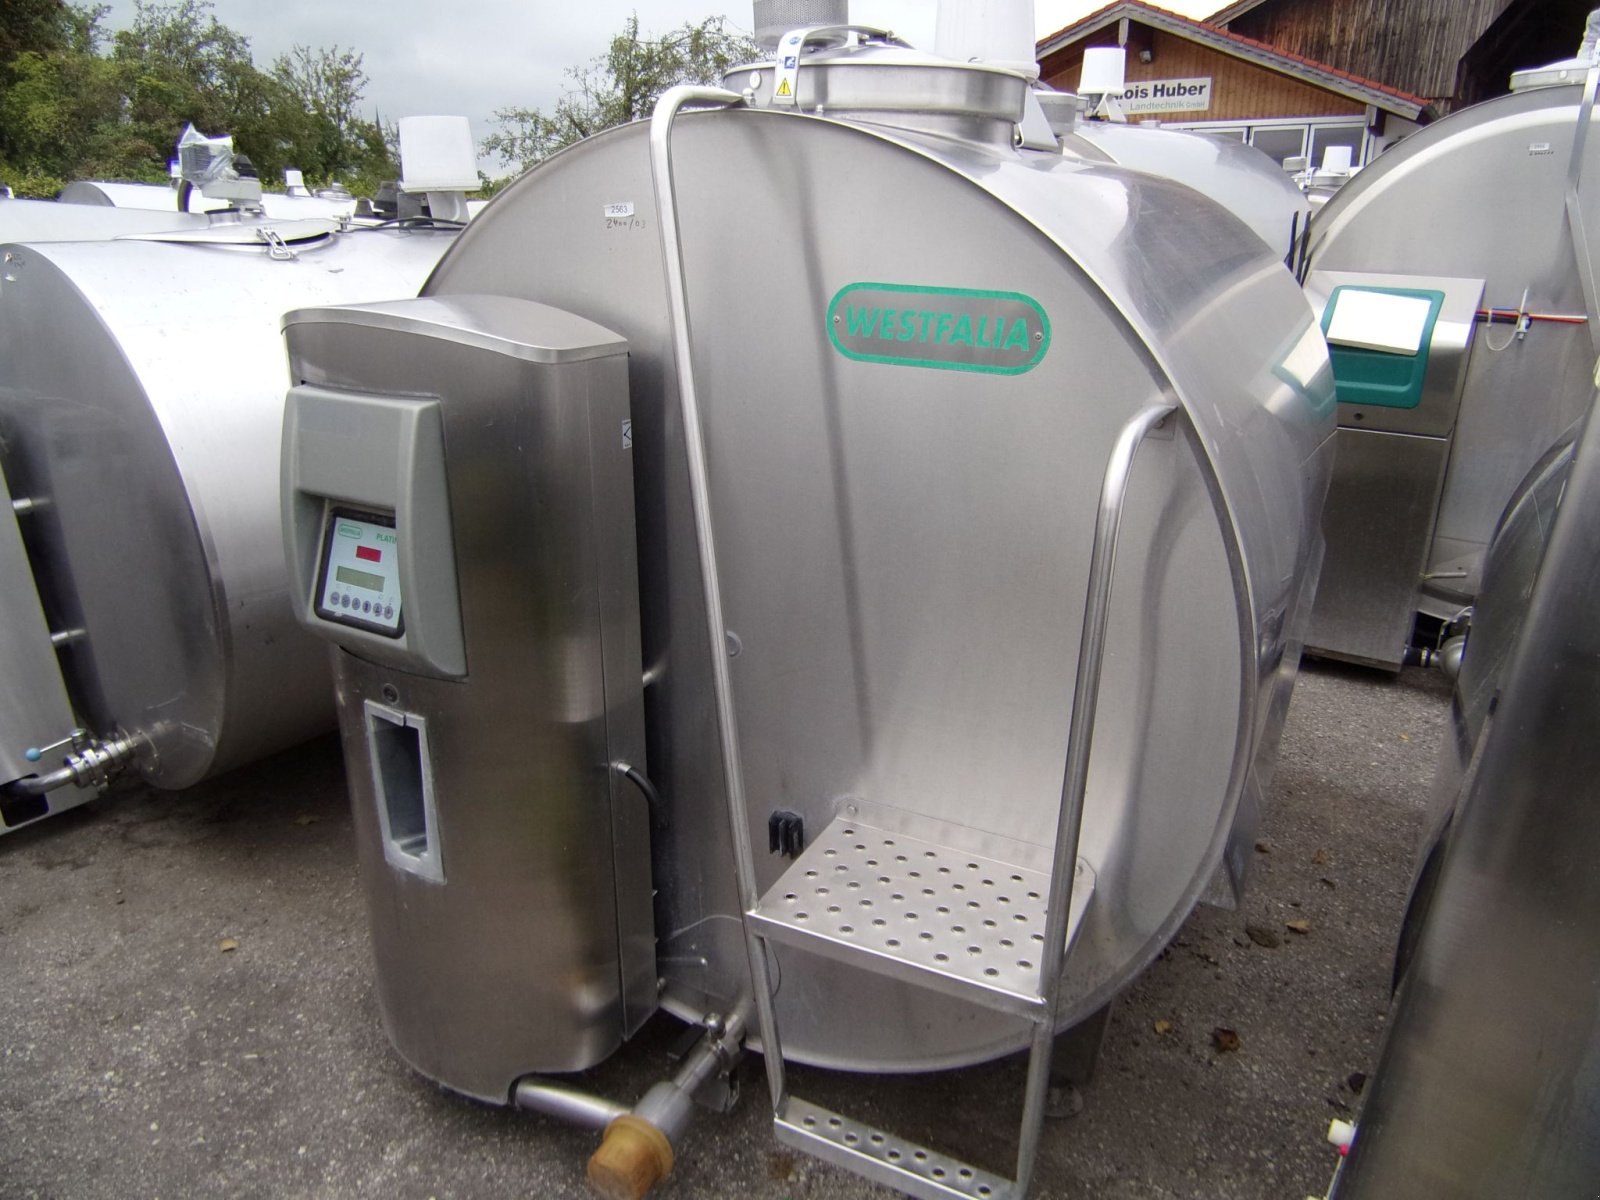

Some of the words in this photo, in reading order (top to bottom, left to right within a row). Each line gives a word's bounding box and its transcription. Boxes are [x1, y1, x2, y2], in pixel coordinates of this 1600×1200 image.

[1114, 86, 1149, 100] ois
[1152, 82, 1206, 98] Huber
[1129, 101, 1184, 112] Landtechnik
[845, 304, 1030, 352] WESTFALIA
